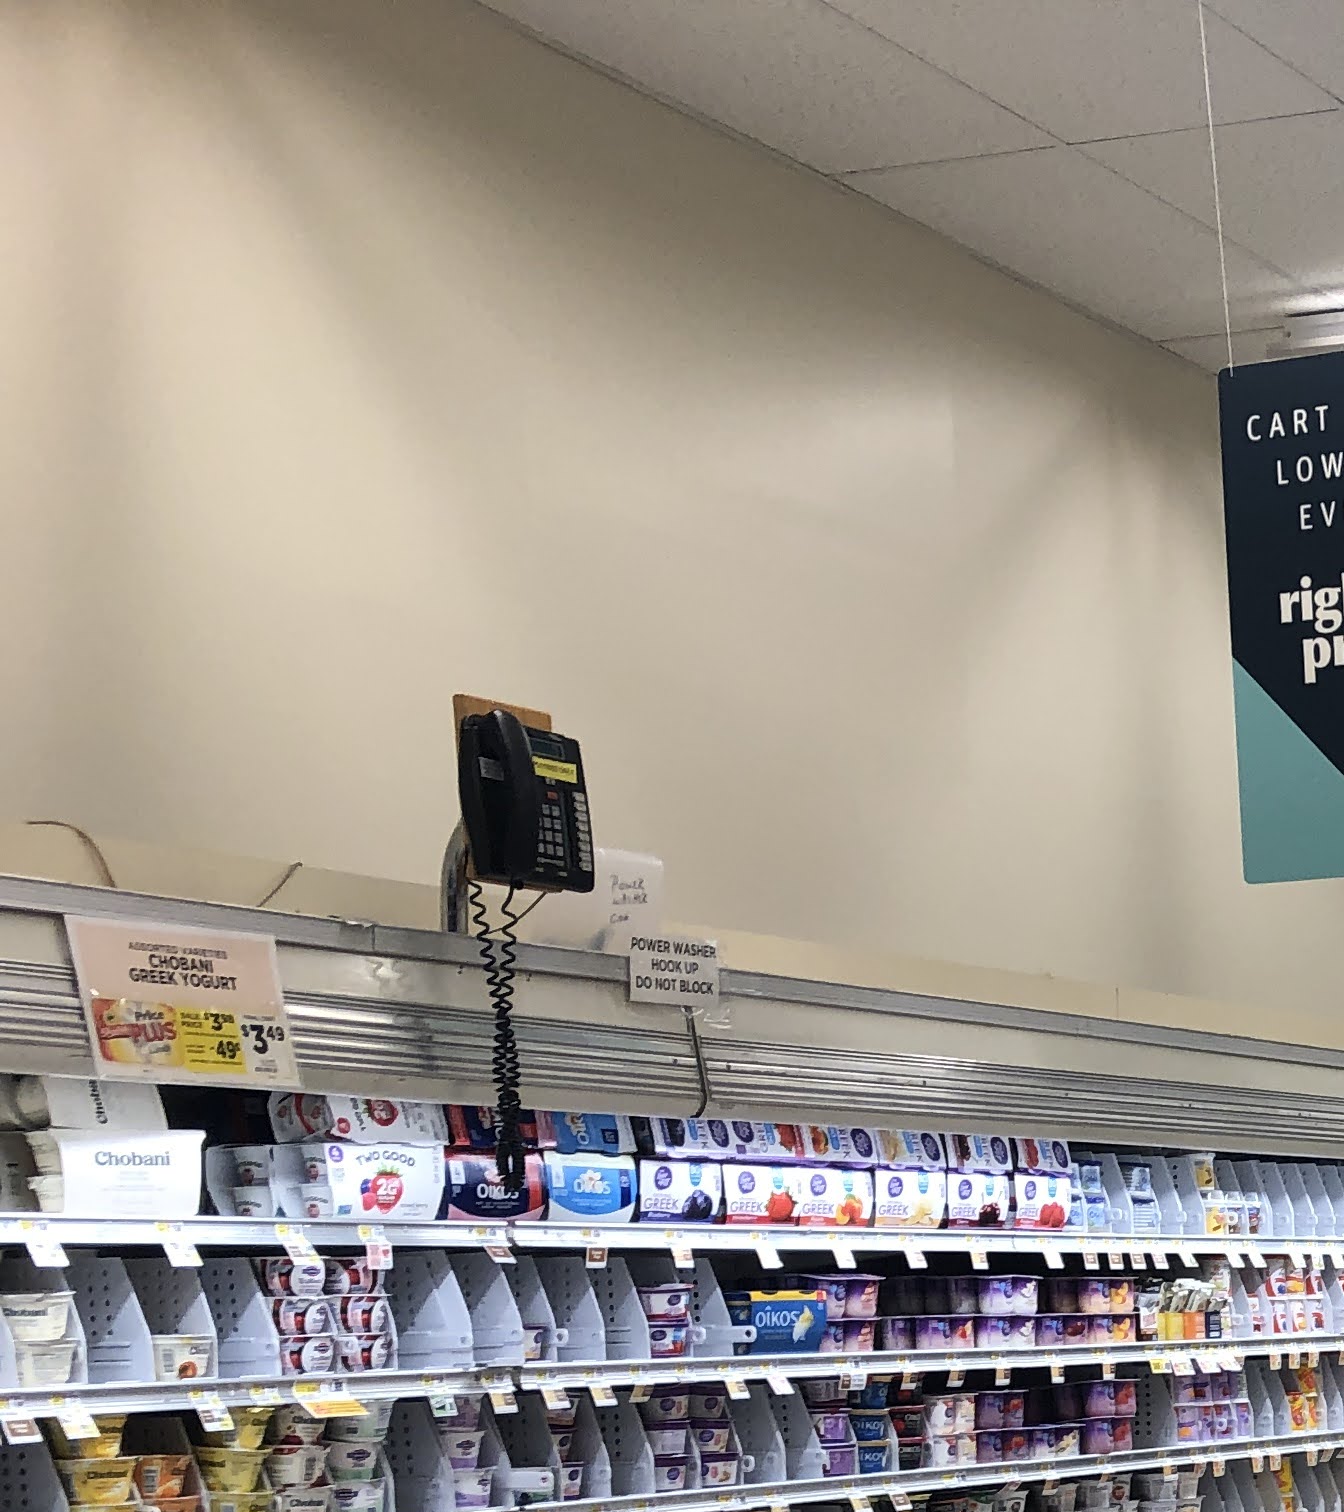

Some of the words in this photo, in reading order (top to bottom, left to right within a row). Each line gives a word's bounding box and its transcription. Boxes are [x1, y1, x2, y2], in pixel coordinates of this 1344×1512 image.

[1247, 405, 1329, 441] CART
[1276, 451, 1344, 485] LOW
[630, 936, 670, 954] POWER
[672, 941, 717, 959] WASHER
[148, 954, 213, 974] CHOBANI
[651, 958, 682, 974] HOOK
[684, 962, 699, 975] UP
[129, 967, 178, 985] GREEK
[180, 973, 237, 991] YOGURT
[635, 975, 653, 989] DO
[655, 977, 677, 991] NOT
[679, 979, 714, 995] BLOCK
[94, 1149, 170, 1167] Chobani
[355, 1150, 380, 1167] TWO
[382, 1150, 416, 1167] GOOD
[643, 1197, 679, 1211] GREEK
[730, 1201, 764, 1214] GREEK
[802, 1203, 835, 1215] GREEK
[878, 1204, 909, 1216] GREEK
[951, 1206, 977, 1218] GREEK
